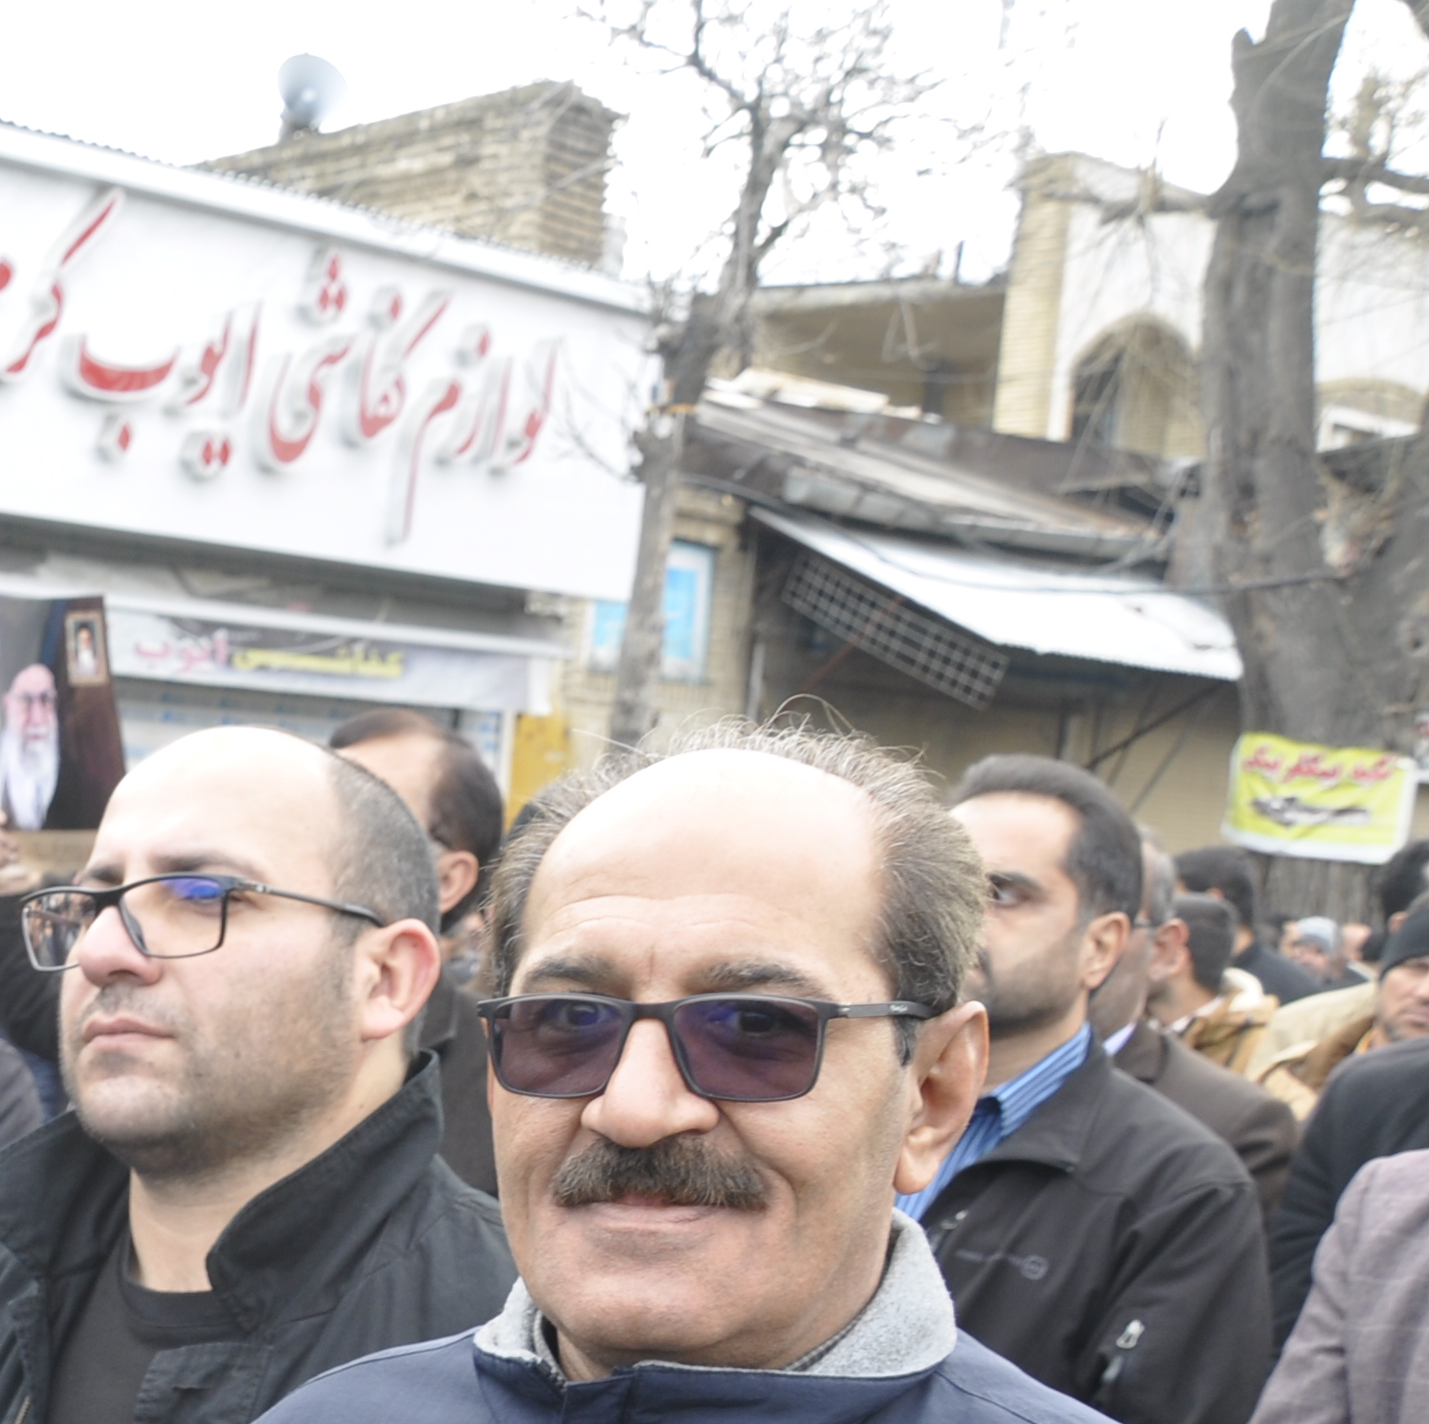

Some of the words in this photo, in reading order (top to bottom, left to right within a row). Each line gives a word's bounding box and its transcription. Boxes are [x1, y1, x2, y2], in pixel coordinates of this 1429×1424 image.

[76, 298, 263, 468] ایوب
[265, 250, 453, 466] کفاشی
[399, 328, 563, 545] لوازم
